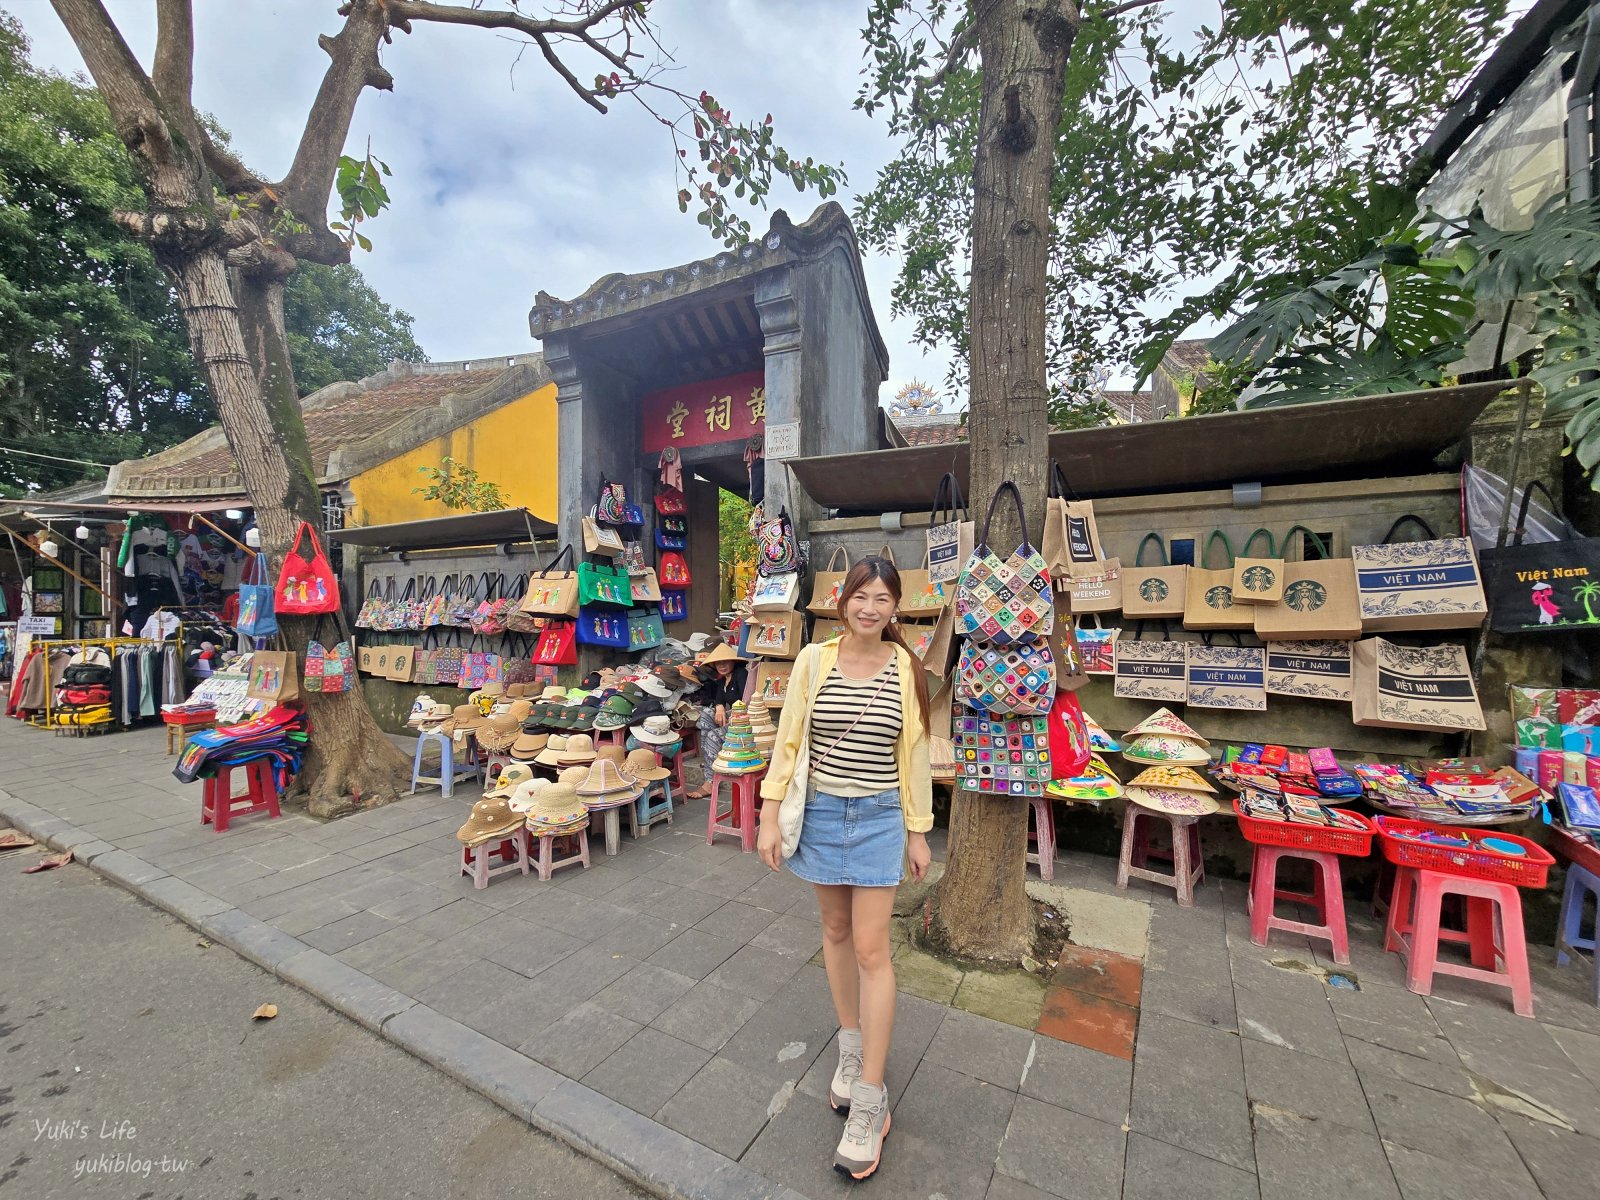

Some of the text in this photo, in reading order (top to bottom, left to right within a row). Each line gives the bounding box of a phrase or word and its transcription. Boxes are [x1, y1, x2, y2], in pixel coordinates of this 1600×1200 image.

[1383, 572, 1447, 585] VIỆT NAM
[1515, 567, 1590, 583] Việt Nam
[1078, 581, 1103, 589] HELLO
[1072, 589, 1111, 598] WEEKEND
[1132, 665, 1170, 674] VIỆT NAM
[1286, 659, 1331, 670] VIỆT NAM
[1206, 672, 1247, 682] VIỆT NAM
[1394, 679, 1440, 693] VIỆT NAM
